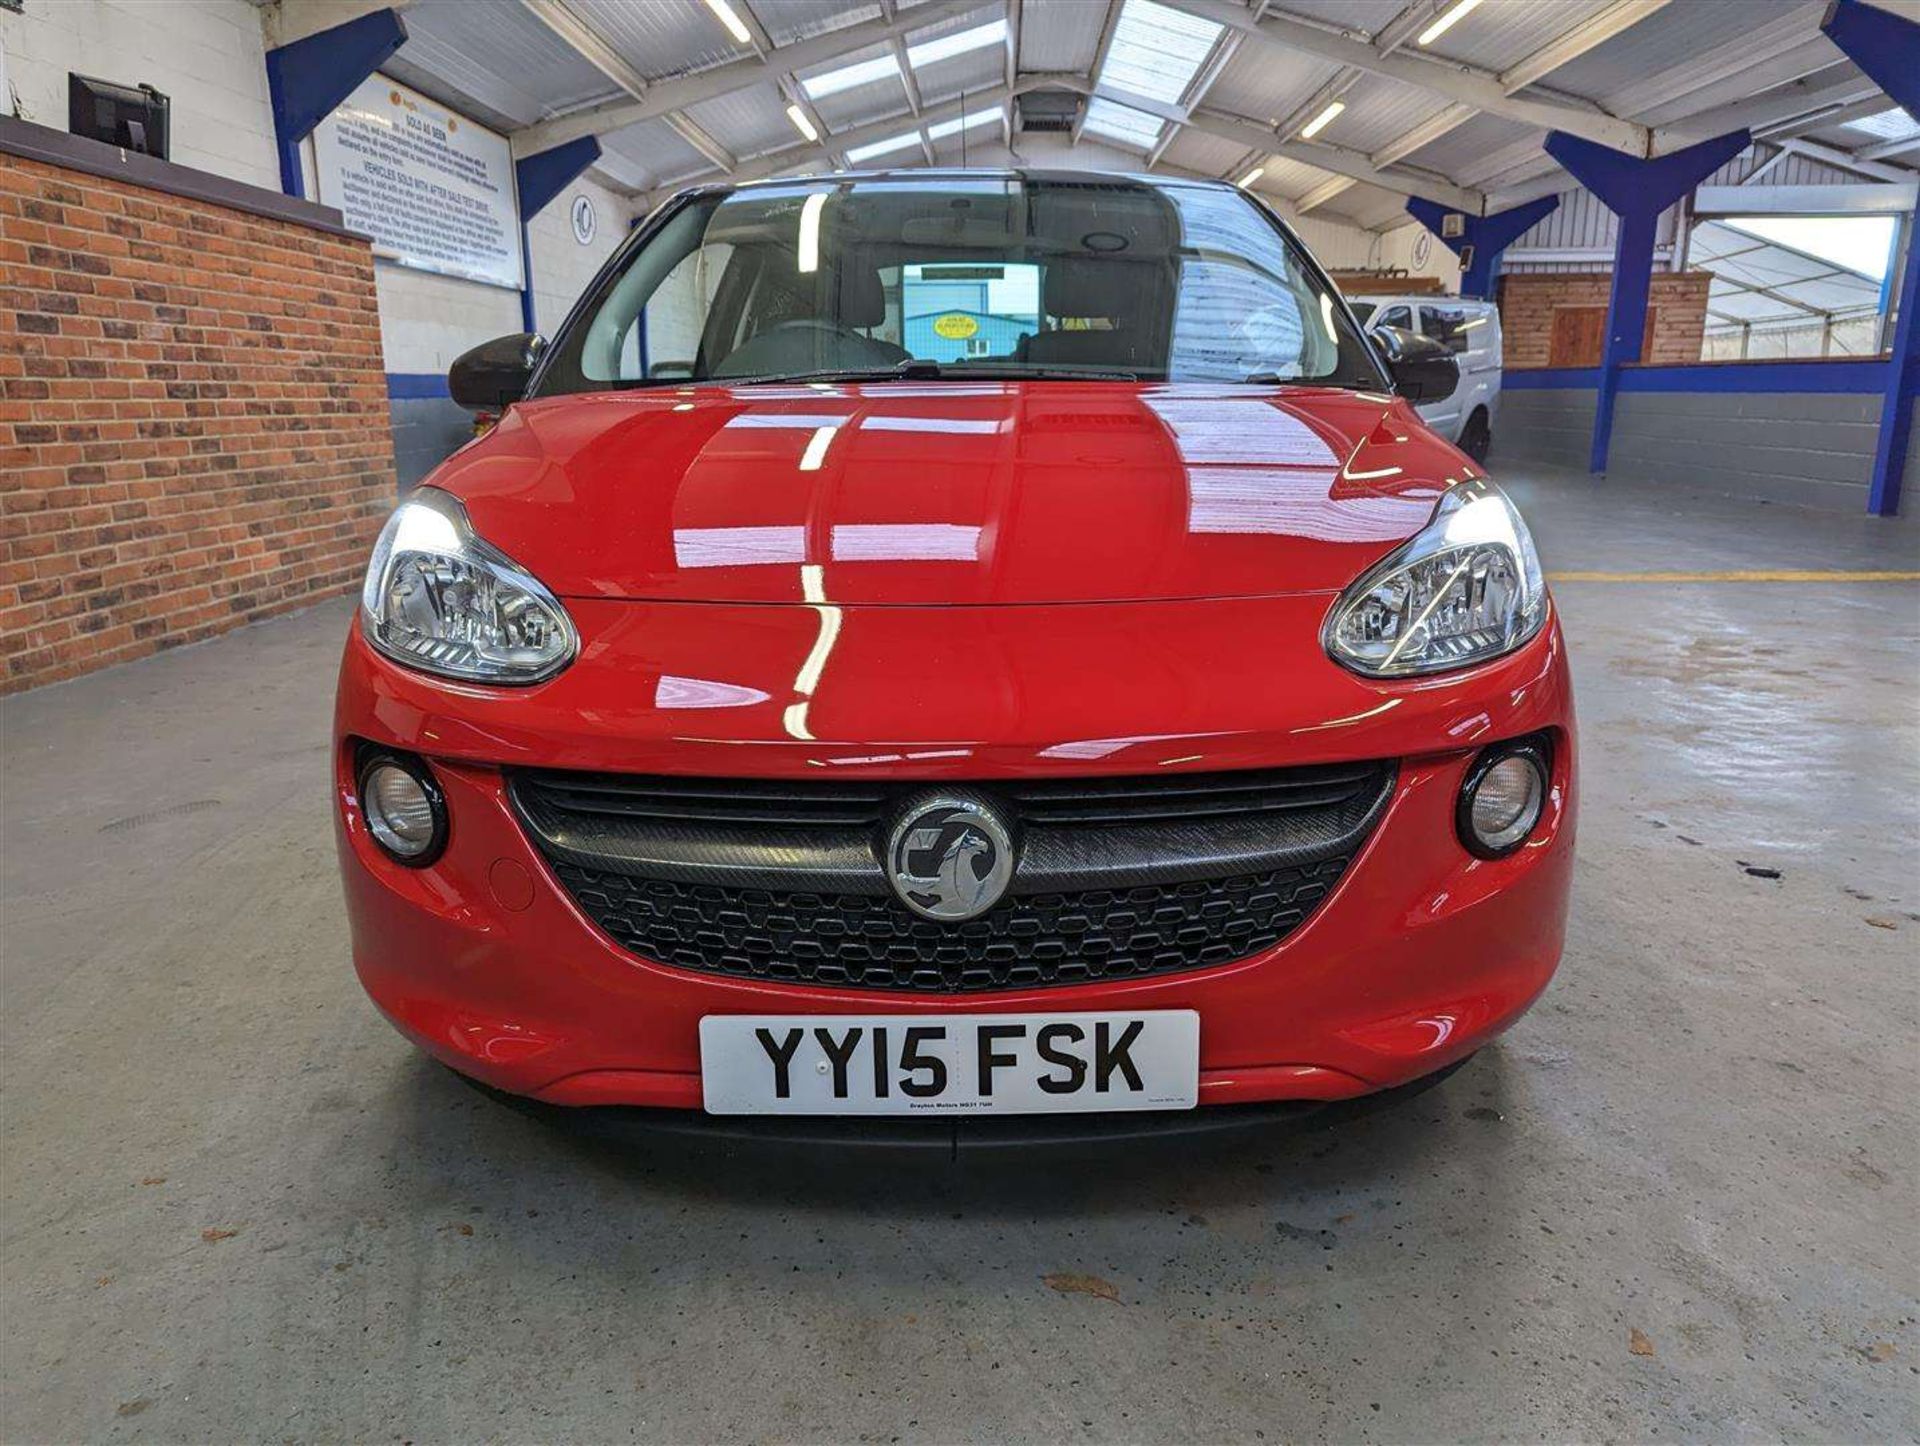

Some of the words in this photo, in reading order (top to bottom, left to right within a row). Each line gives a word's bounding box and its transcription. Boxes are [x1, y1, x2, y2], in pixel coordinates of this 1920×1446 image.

[406, 115, 422, 132] SOLD
[397, 172, 413, 188] SOLD
[755, 1026, 947, 1098] YY15
[977, 1021, 1144, 1096] FSK
